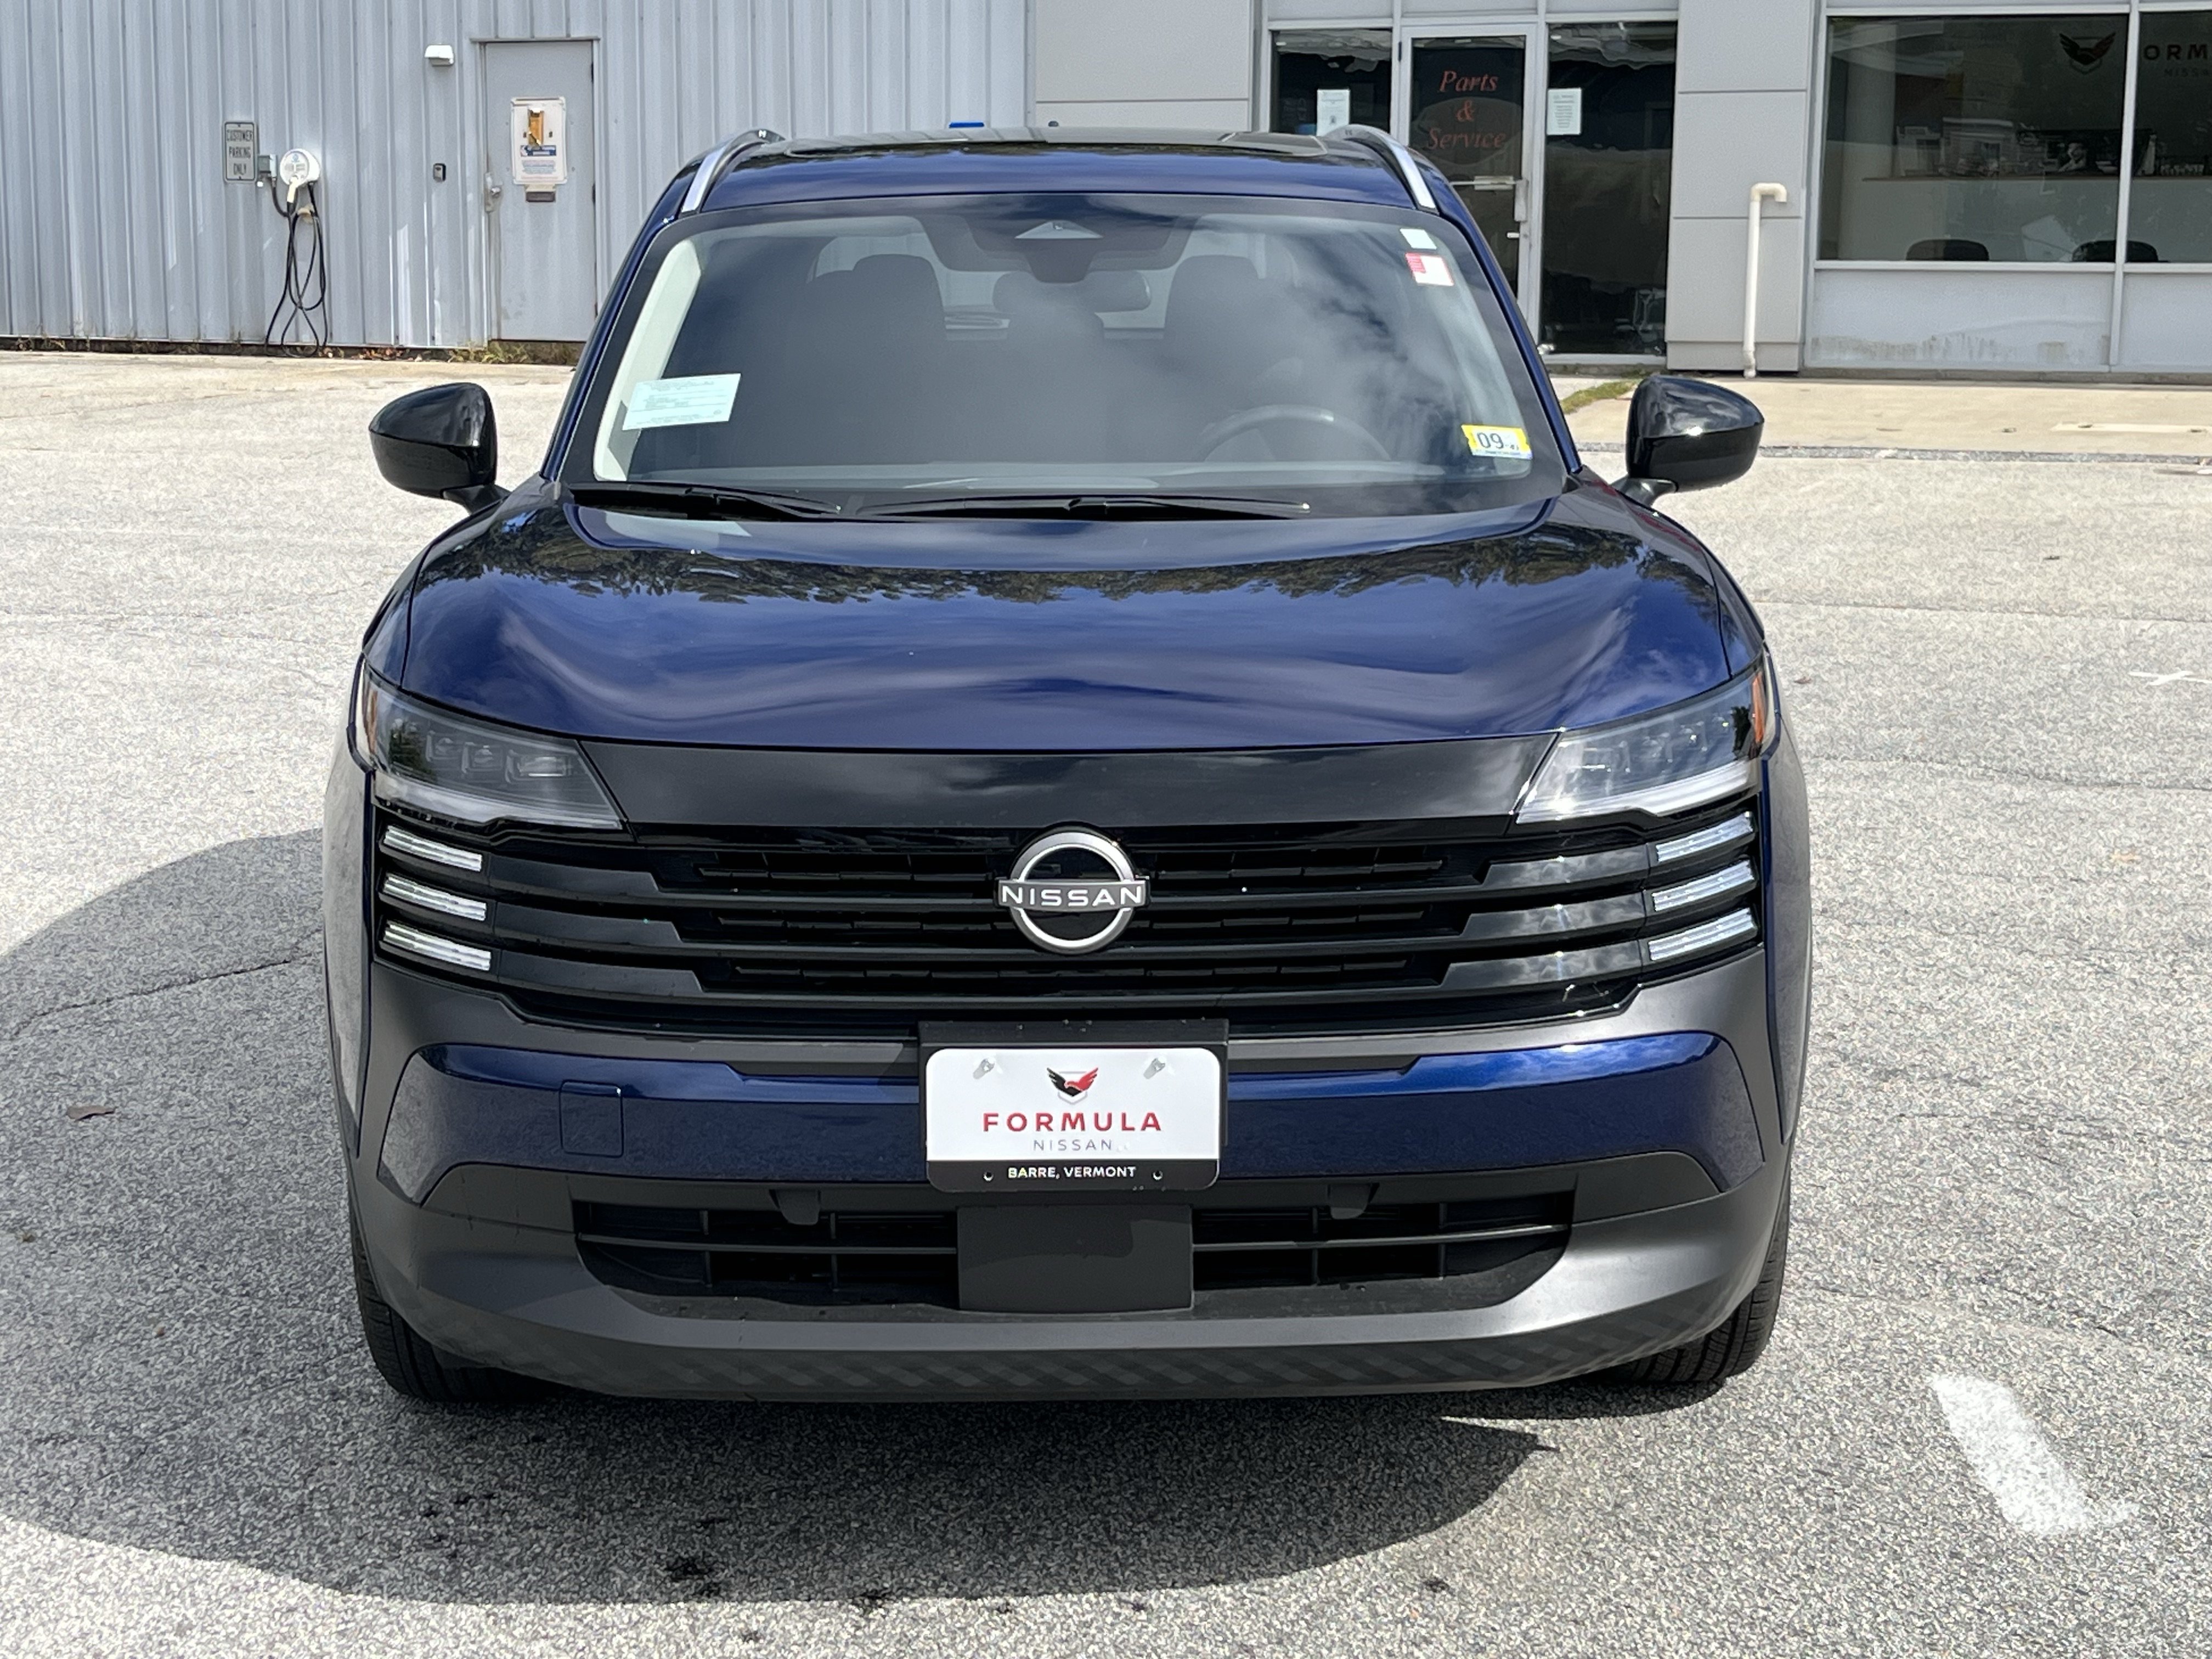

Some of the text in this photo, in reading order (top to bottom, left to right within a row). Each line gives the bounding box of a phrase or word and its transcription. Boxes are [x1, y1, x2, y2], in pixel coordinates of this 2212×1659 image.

[2143, 43, 2208, 60] ORM
[1437, 70, 1498, 92] Parts
[1457, 99, 1474, 122] &
[227, 129, 253, 142] CUSTOMER
[1426, 127, 1506, 149] Service
[229, 146, 251, 159] PARKING
[233, 163, 247, 175] ONLY
[1477, 432, 1504, 449] 09
[1002, 885, 1142, 906] NISSAN
[983, 1112, 1161, 1132] FORMULA
[1034, 1139, 1113, 1151] NISSAN
[1008, 1166, 1136, 1179] BARRE, VERMONT
